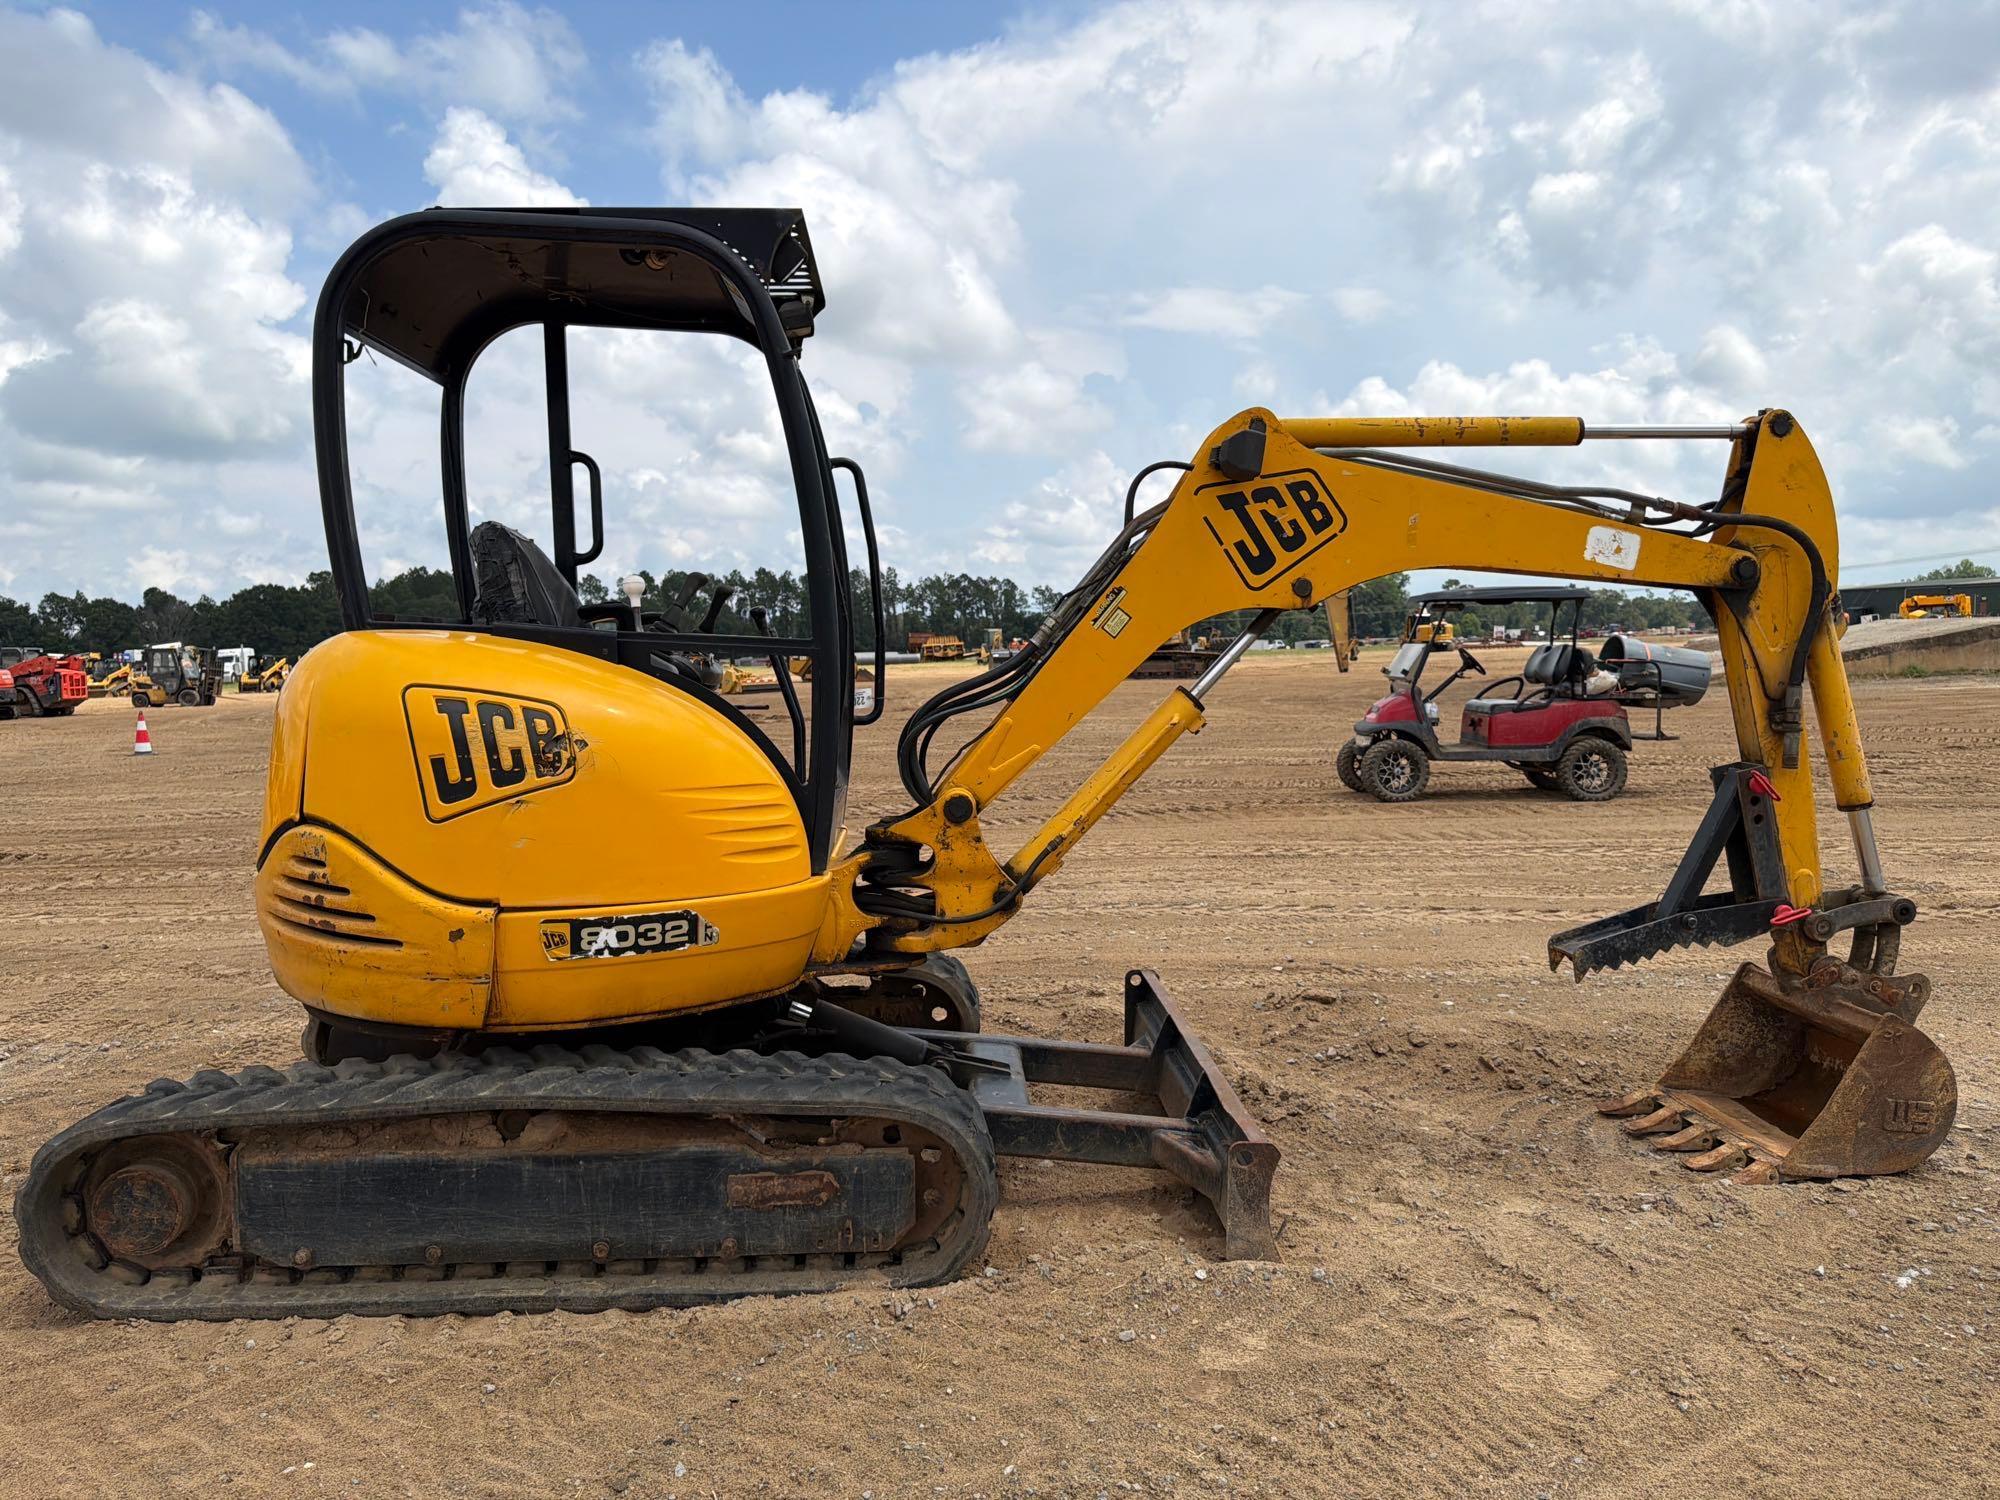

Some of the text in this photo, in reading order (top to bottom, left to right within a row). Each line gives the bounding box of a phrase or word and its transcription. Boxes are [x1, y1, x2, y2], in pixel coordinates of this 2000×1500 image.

[1216, 480, 1334, 575] JCB
[429, 696, 564, 805] JCB
[543, 920, 689, 951] JCB 8032
[704, 919, 713, 942] ZT
